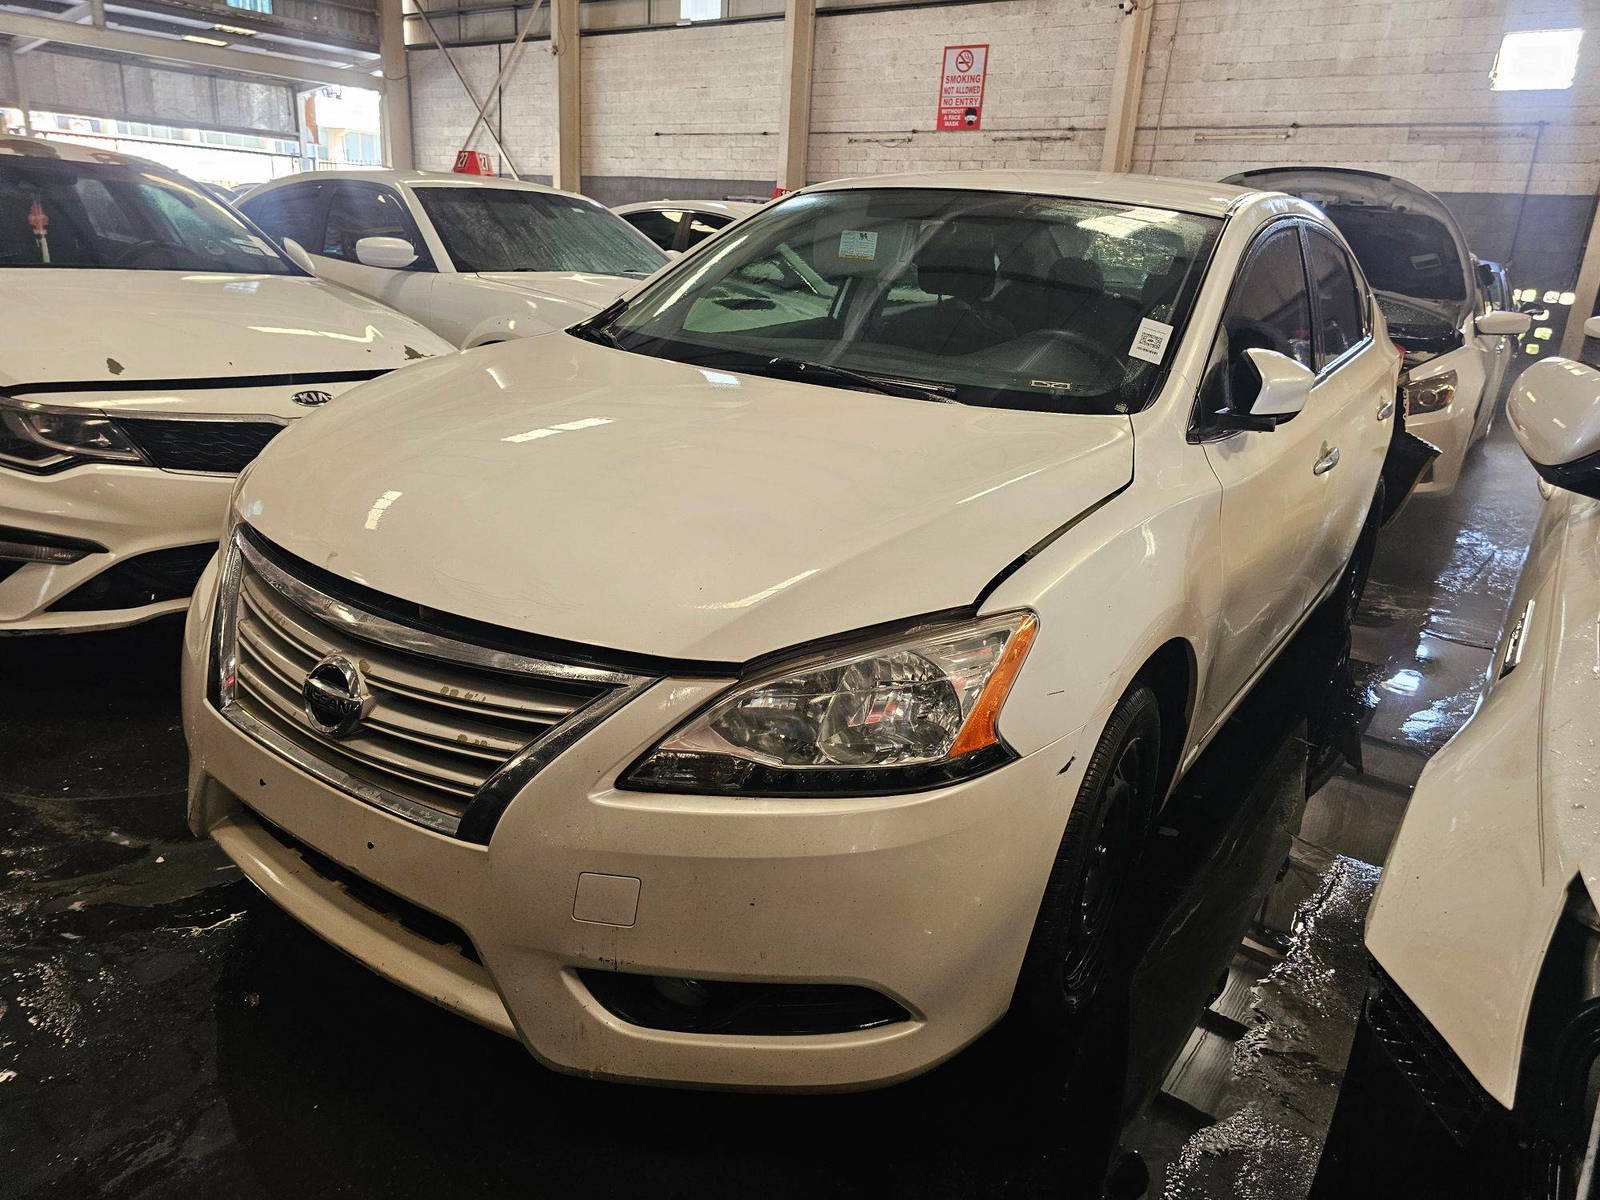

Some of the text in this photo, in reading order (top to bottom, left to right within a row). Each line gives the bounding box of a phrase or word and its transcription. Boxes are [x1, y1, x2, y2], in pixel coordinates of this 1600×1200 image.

[945, 75, 981, 84] SMOKING
[943, 86, 980, 95] NOT ALLOWED
[955, 97, 979, 106] ENTRY
[458, 151, 469, 168] 27
[298, 391, 330, 403] KIA
[303, 682, 352, 715] NISSAN
